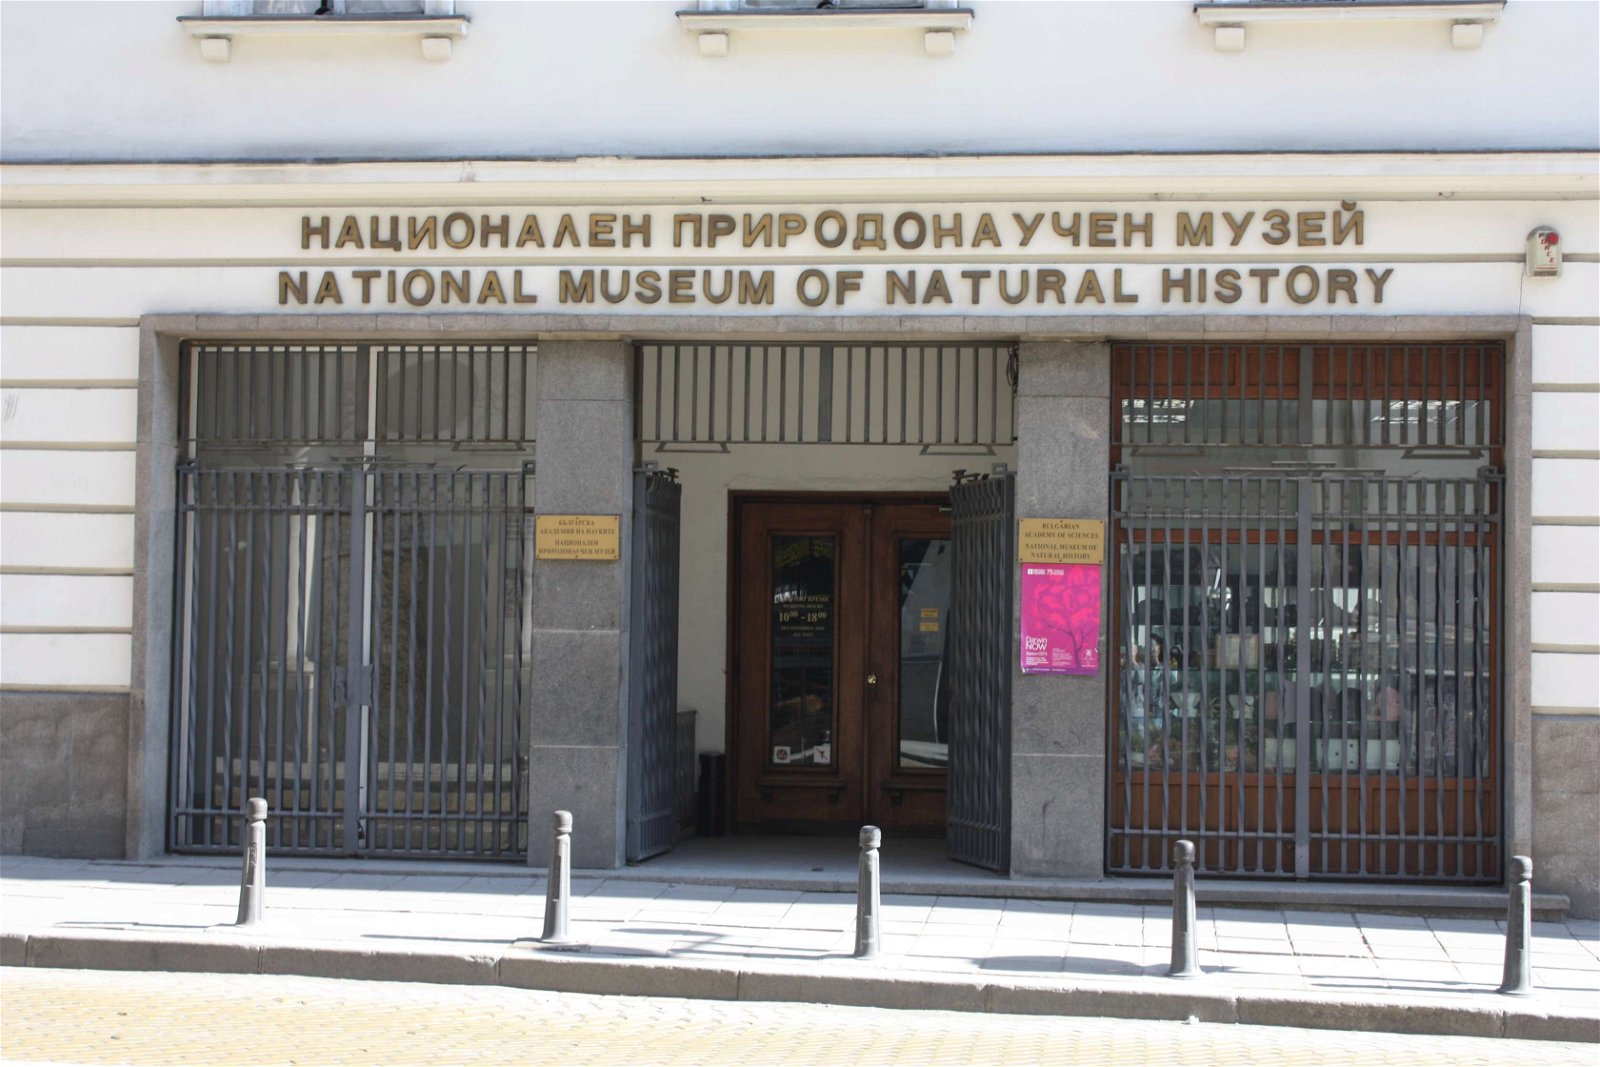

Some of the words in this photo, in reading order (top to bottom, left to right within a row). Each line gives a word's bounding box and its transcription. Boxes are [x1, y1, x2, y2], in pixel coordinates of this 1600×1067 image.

[301, 211, 652, 251] НАЦИОНАЛЕН
[672, 209, 1154, 250] ПРИРОДОНАУЧЕН
[1176, 198, 1365, 247] МУЗЕЙ
[278, 268, 538, 308] NATIONAL
[558, 268, 775, 307] MUSEUM
[796, 268, 864, 308] OF
[886, 268, 1139, 306] NATURAL
[1161, 264, 1394, 306] HISTORY
